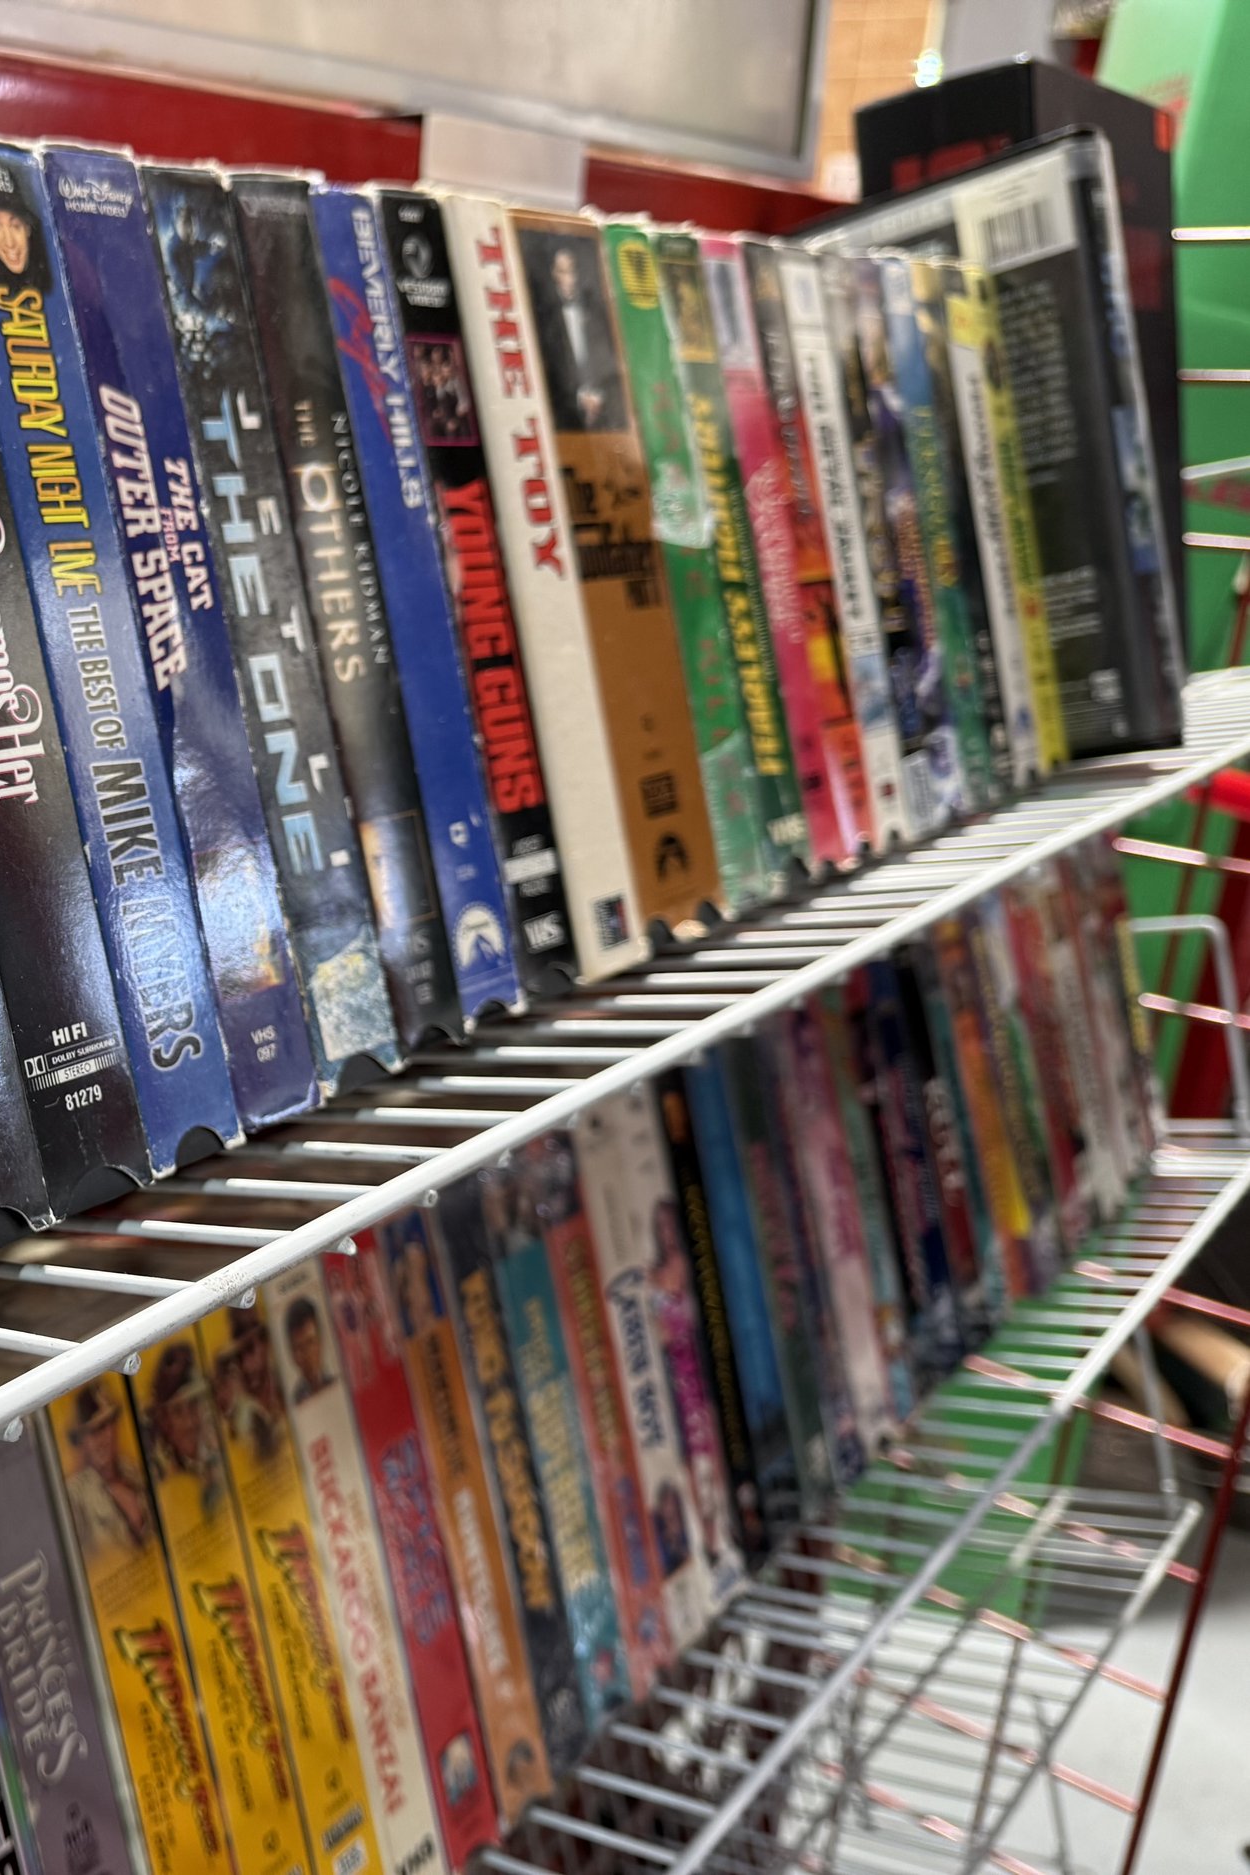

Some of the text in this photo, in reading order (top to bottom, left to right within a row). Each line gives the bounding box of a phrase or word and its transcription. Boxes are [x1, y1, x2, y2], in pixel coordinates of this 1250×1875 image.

[294, 399, 318, 449] THE
[352, 207, 401, 385] BEVERLY
[385, 393, 426, 511] HILLS
[476, 225, 569, 581] THE TOY
[27, 442, 90, 529] NIGHT
[99, 383, 187, 693] OUTER SPACE
[159, 506, 181, 562] FROM
[162, 456, 214, 612] THE CAT
[331, 410, 367, 528] NICOLE
[354, 541, 390, 665] KIDMAN
[46, 540, 102, 597] LIVE
[202, 389, 325, 875] THE ONE
[293, 460, 367, 684] OTHERS
[442, 478, 512, 658] YOUNG
[66, 603, 126, 751] THE BEST OF
[473, 667, 546, 815] GUNS
[91, 761, 166, 887] MIKE
[52, 1022, 88, 1047] HI FI
[52, 1038, 116, 1065] DOLBY SURROUND
[64, 1062, 92, 1080] STEREO
[65, 1084, 102, 1111] 81279
[251, 1025, 276, 1045] VHS
